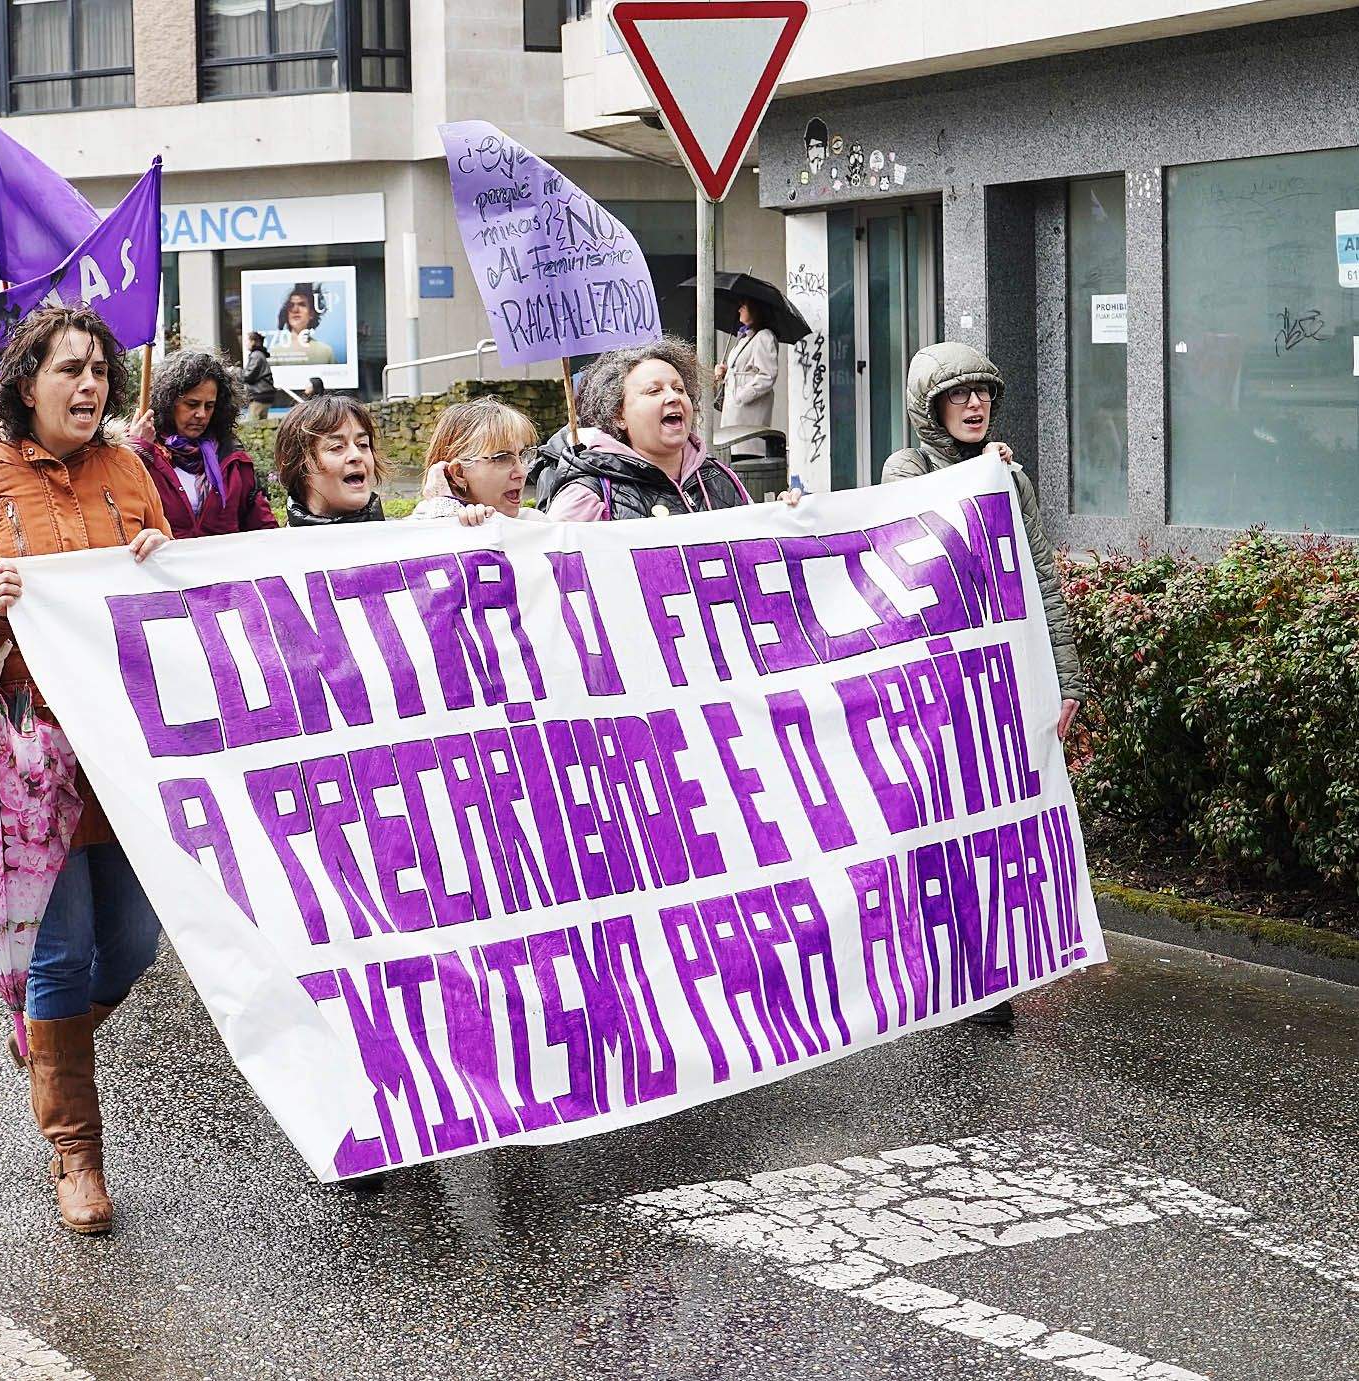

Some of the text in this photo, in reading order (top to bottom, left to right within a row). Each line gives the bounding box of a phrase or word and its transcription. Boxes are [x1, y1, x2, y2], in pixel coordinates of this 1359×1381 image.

[487, 246, 529, 289] AL
[565, 200, 617, 246] NO
[500, 278, 657, 352] RACIALIZADO
[105, 491, 1027, 758] CONTRA O FASCISMO
[158, 778, 259, 928] A
[701, 701, 791, 868] E
[765, 690, 857, 854] O
[659, 877, 852, 1085] PARA
